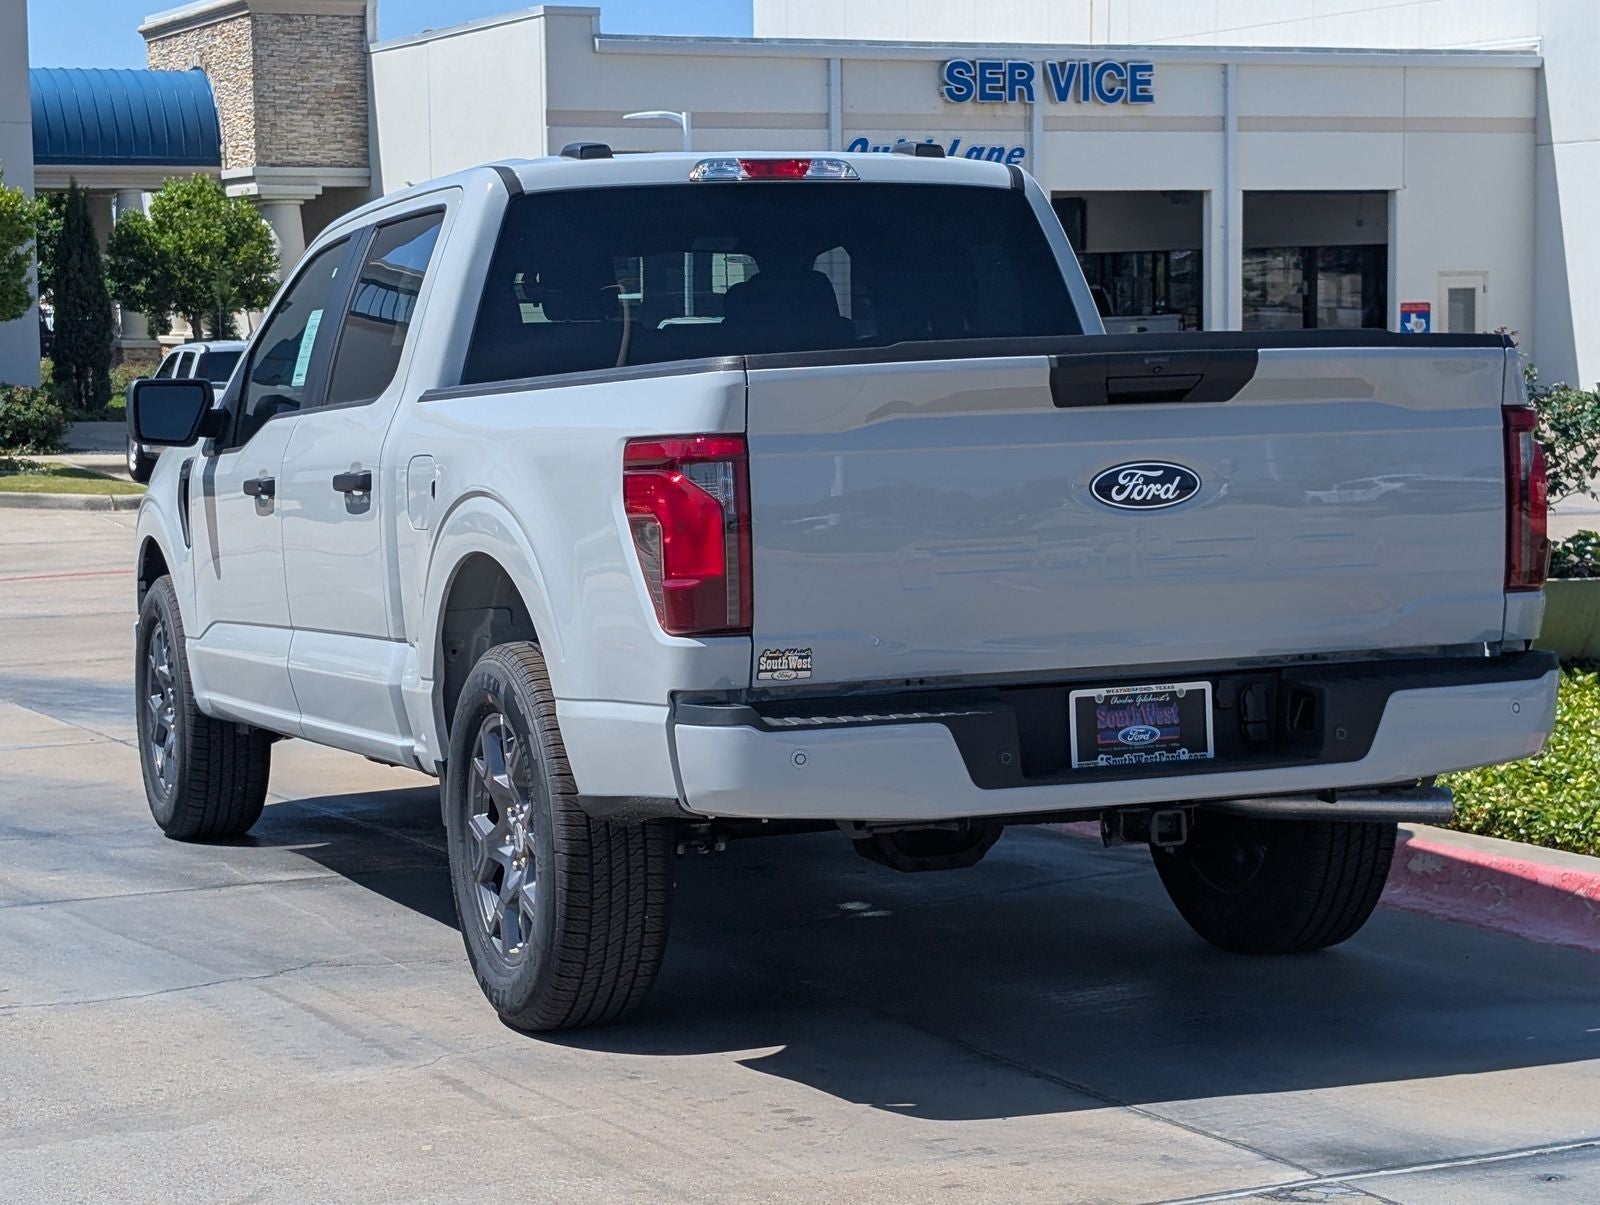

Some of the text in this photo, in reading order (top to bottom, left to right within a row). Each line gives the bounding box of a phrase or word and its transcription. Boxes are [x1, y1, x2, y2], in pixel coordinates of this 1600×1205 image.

[949, 138, 1026, 165] Lane
[1111, 469, 1181, 501] Ford
[760, 656, 812, 670] SouthWest
[1127, 728, 1152, 741] Ford
